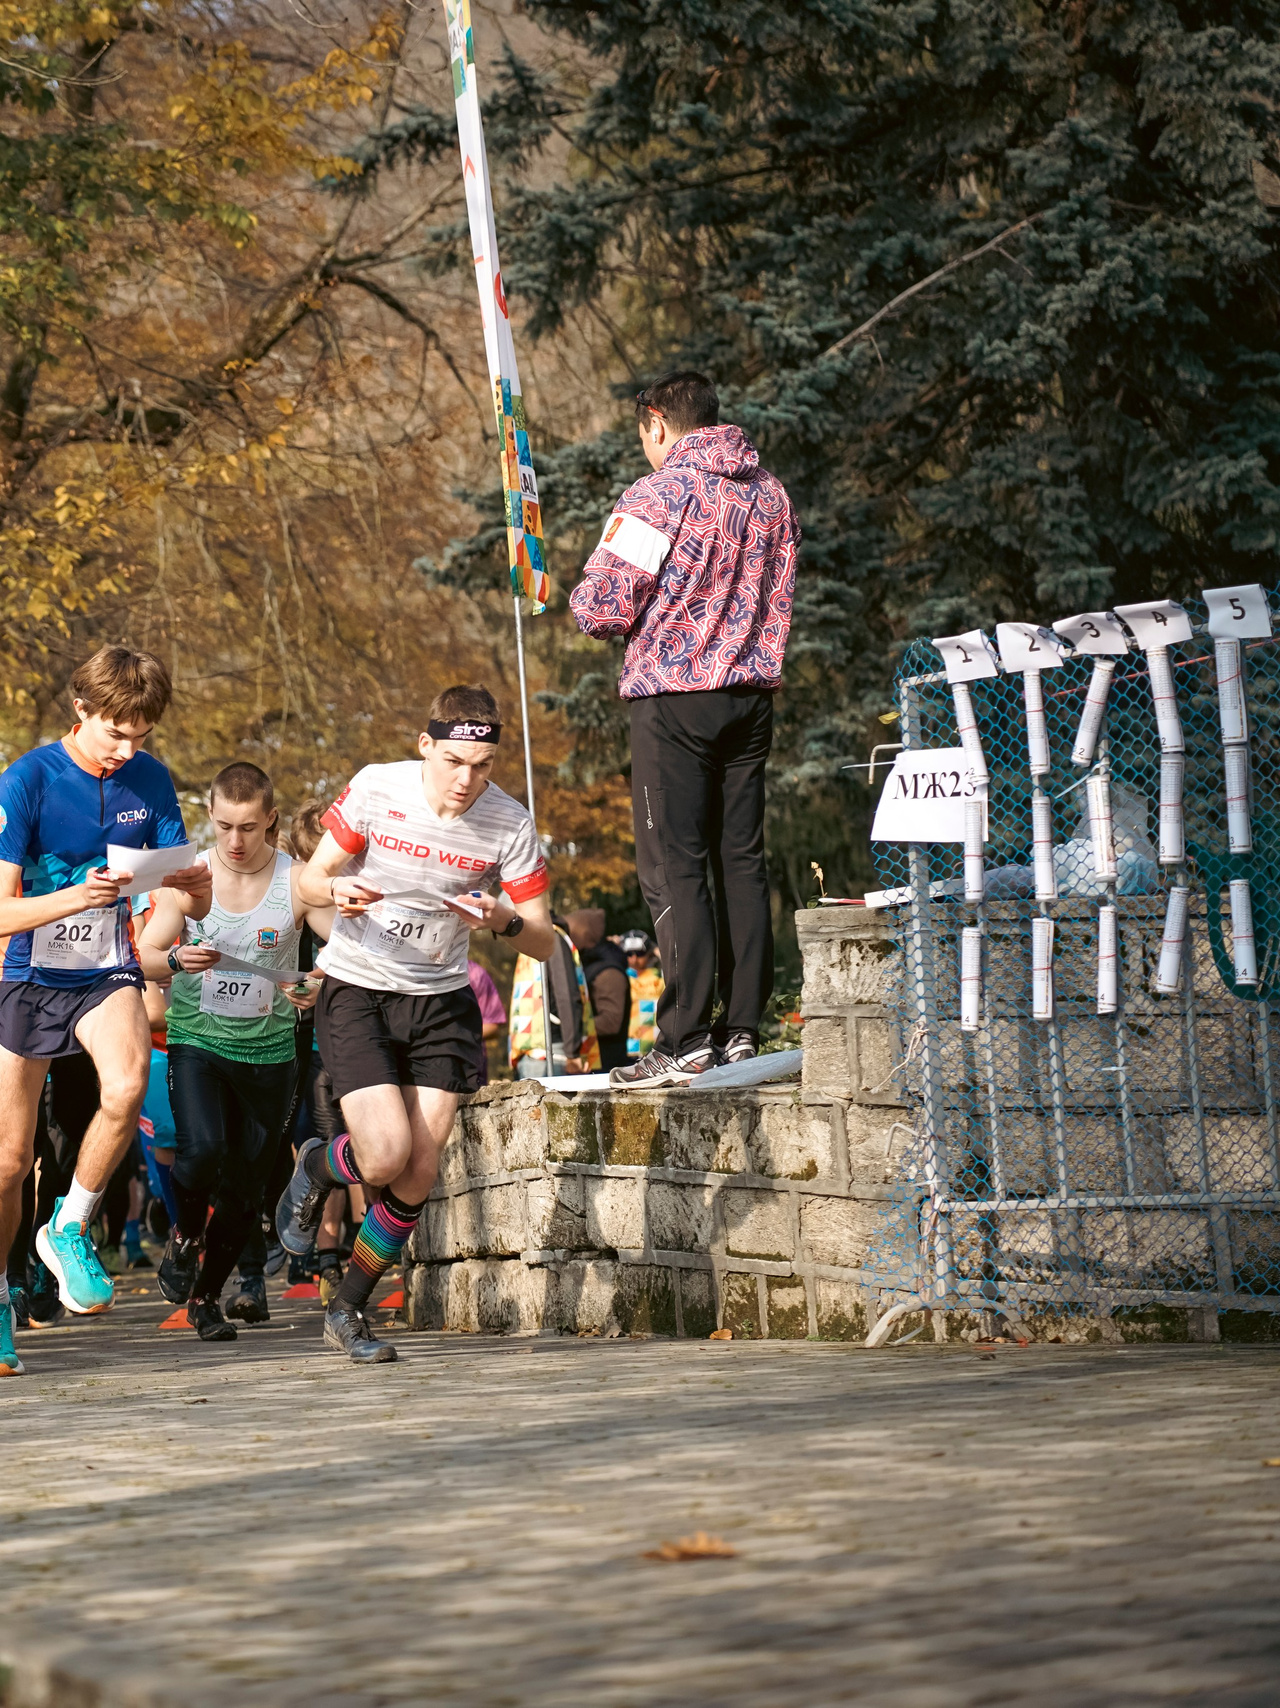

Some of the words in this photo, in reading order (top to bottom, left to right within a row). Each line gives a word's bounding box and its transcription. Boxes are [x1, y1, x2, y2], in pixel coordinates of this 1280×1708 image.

[1228, 598, 1246, 620] 5
[1151, 610, 1168, 626] 4
[1081, 622, 1100, 638] 3
[1024, 632, 1040, 653] 2
[956, 645, 973, 663] 1
[371, 831, 431, 858] NORD
[54, 924, 92, 941] 202
[99, 931, 104, 942] 1
[379, 932, 404, 946] МЖ16
[386, 920, 425, 939] 201
[433, 933, 438, 942] 1
[46, 941, 74, 950] МЖ16
[212, 994, 234, 1002] МЖ16
[217, 981, 251, 996] 207
[257, 990, 262, 998] 1
